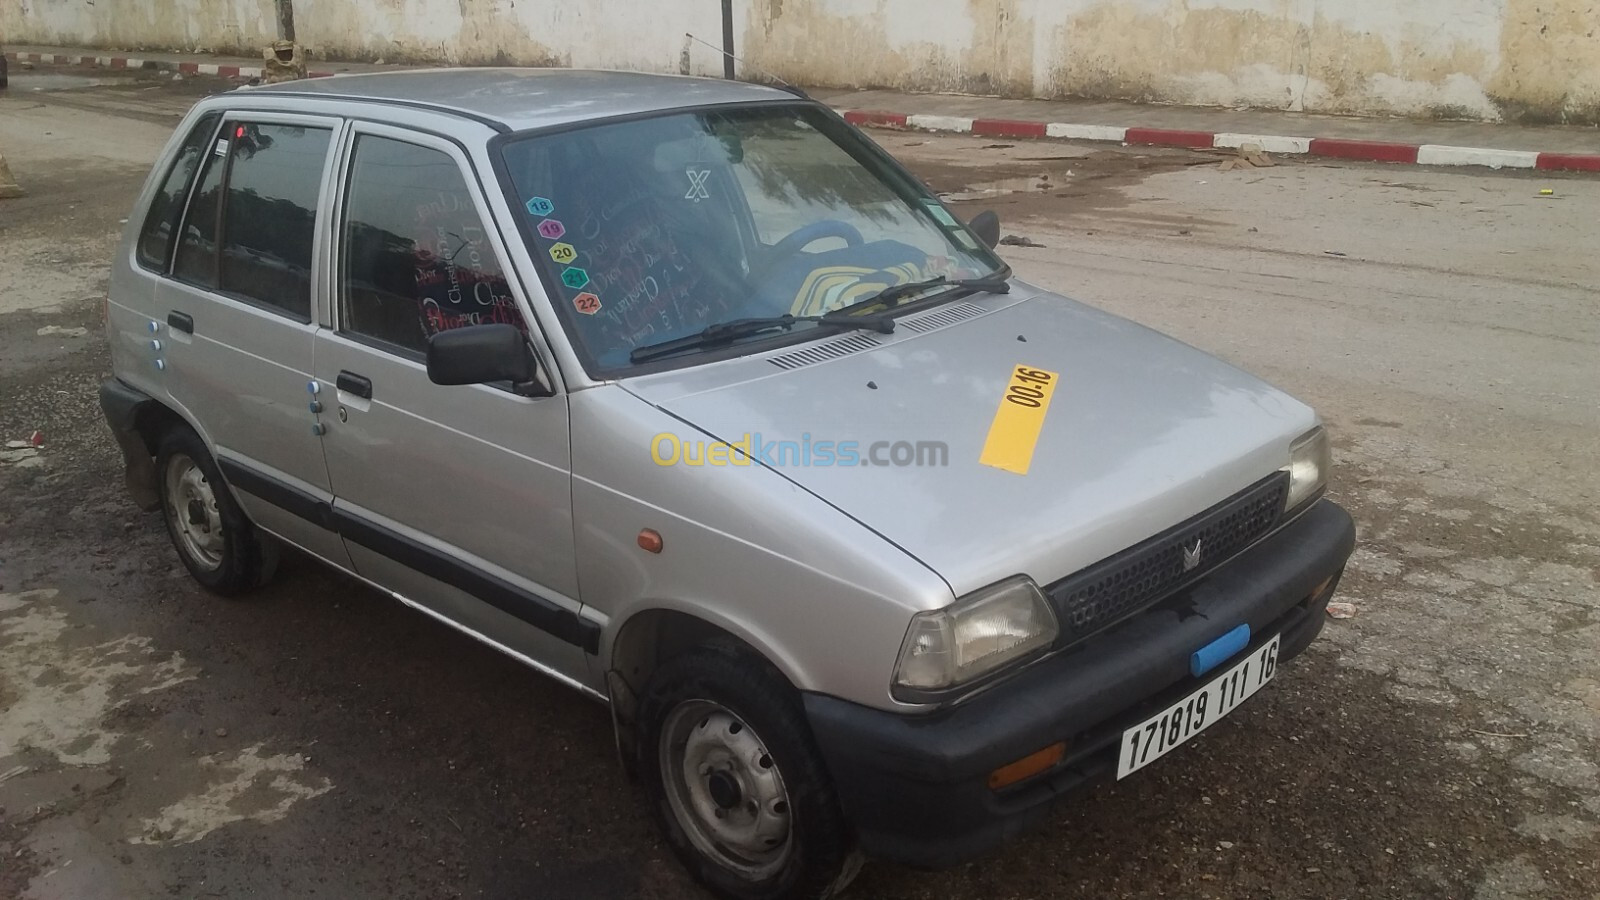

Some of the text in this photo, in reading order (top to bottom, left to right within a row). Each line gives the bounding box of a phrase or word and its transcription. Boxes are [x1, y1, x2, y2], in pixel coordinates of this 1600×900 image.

[532, 202, 549, 212] 18
[543, 224, 560, 234] 19
[554, 247, 572, 259] 20
[566, 272, 584, 284] 21
[578, 297, 597, 310] 22
[1006, 367, 1051, 408] 00-16
[1129, 641, 1277, 770] 171819 111 16
